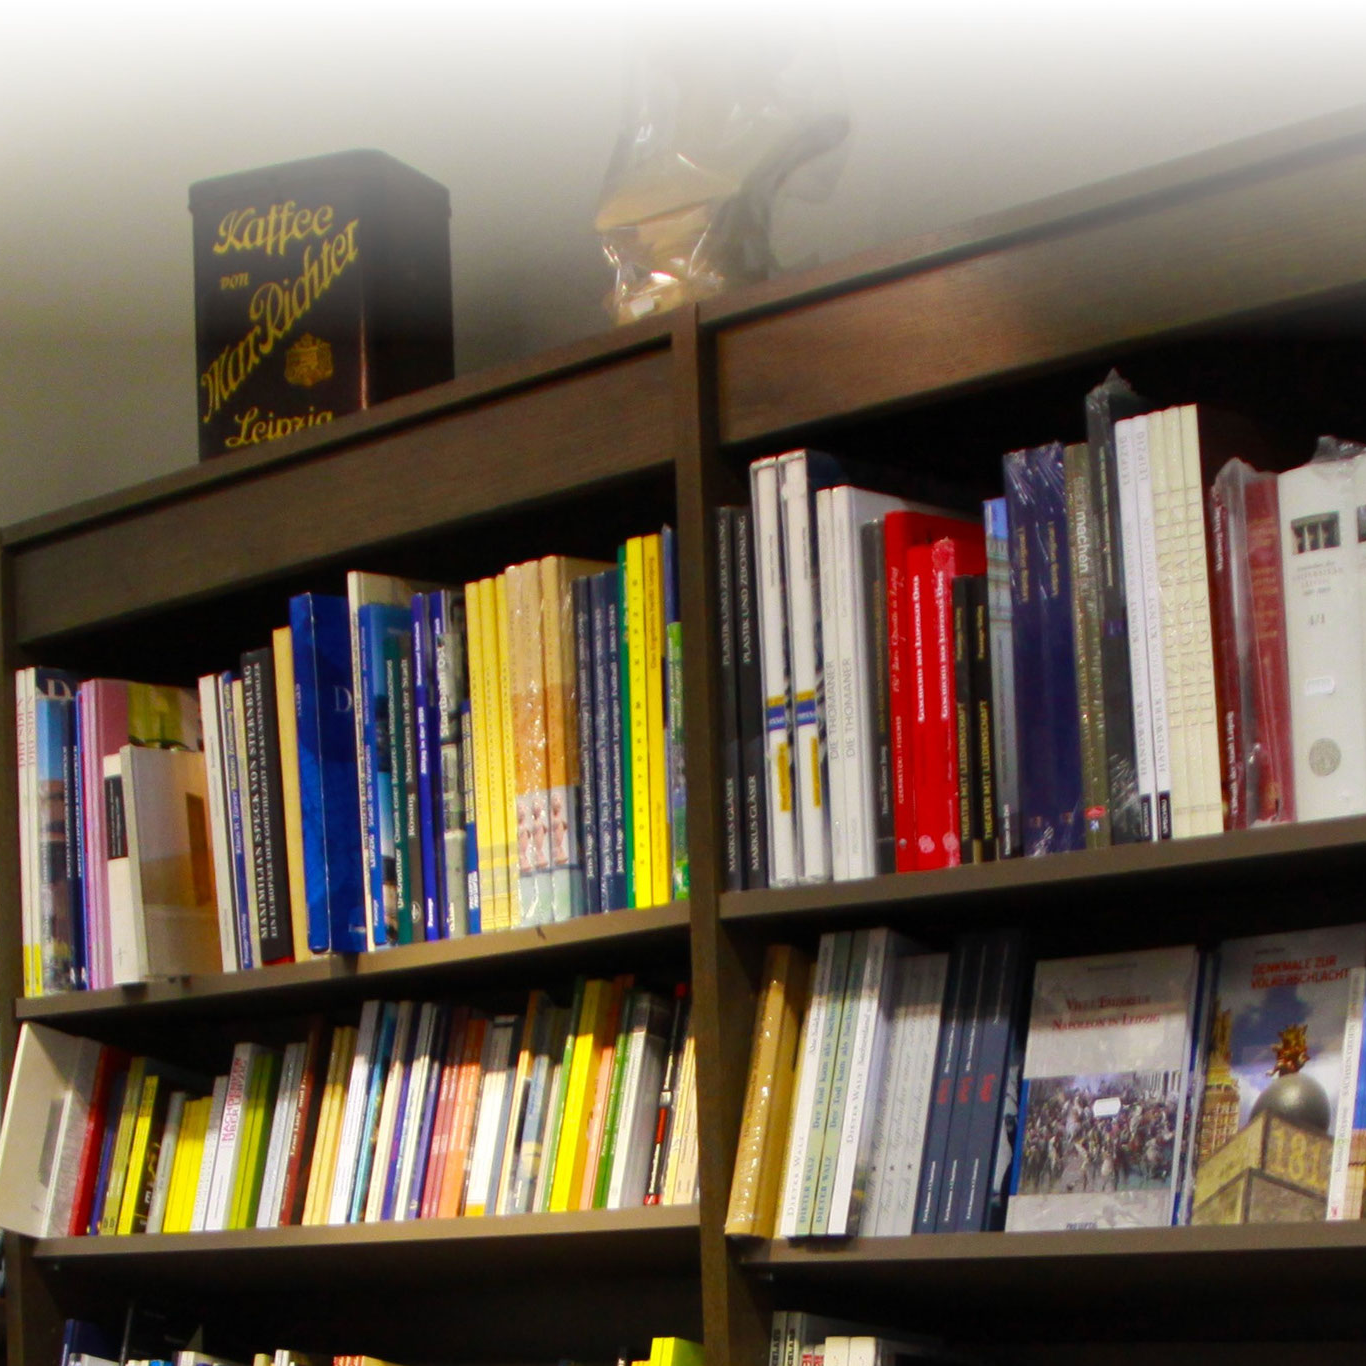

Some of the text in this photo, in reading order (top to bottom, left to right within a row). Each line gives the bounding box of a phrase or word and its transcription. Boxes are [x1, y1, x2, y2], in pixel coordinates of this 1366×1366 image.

[212, 201, 333, 255] Kaffee
[219, 272, 249, 291] von
[1186, 484, 1215, 727] LEIPZIGER BALLETT
[400, 658, 409, 689] Stadt
[402, 693, 410, 711] der
[404, 730, 414, 783] Menschen
